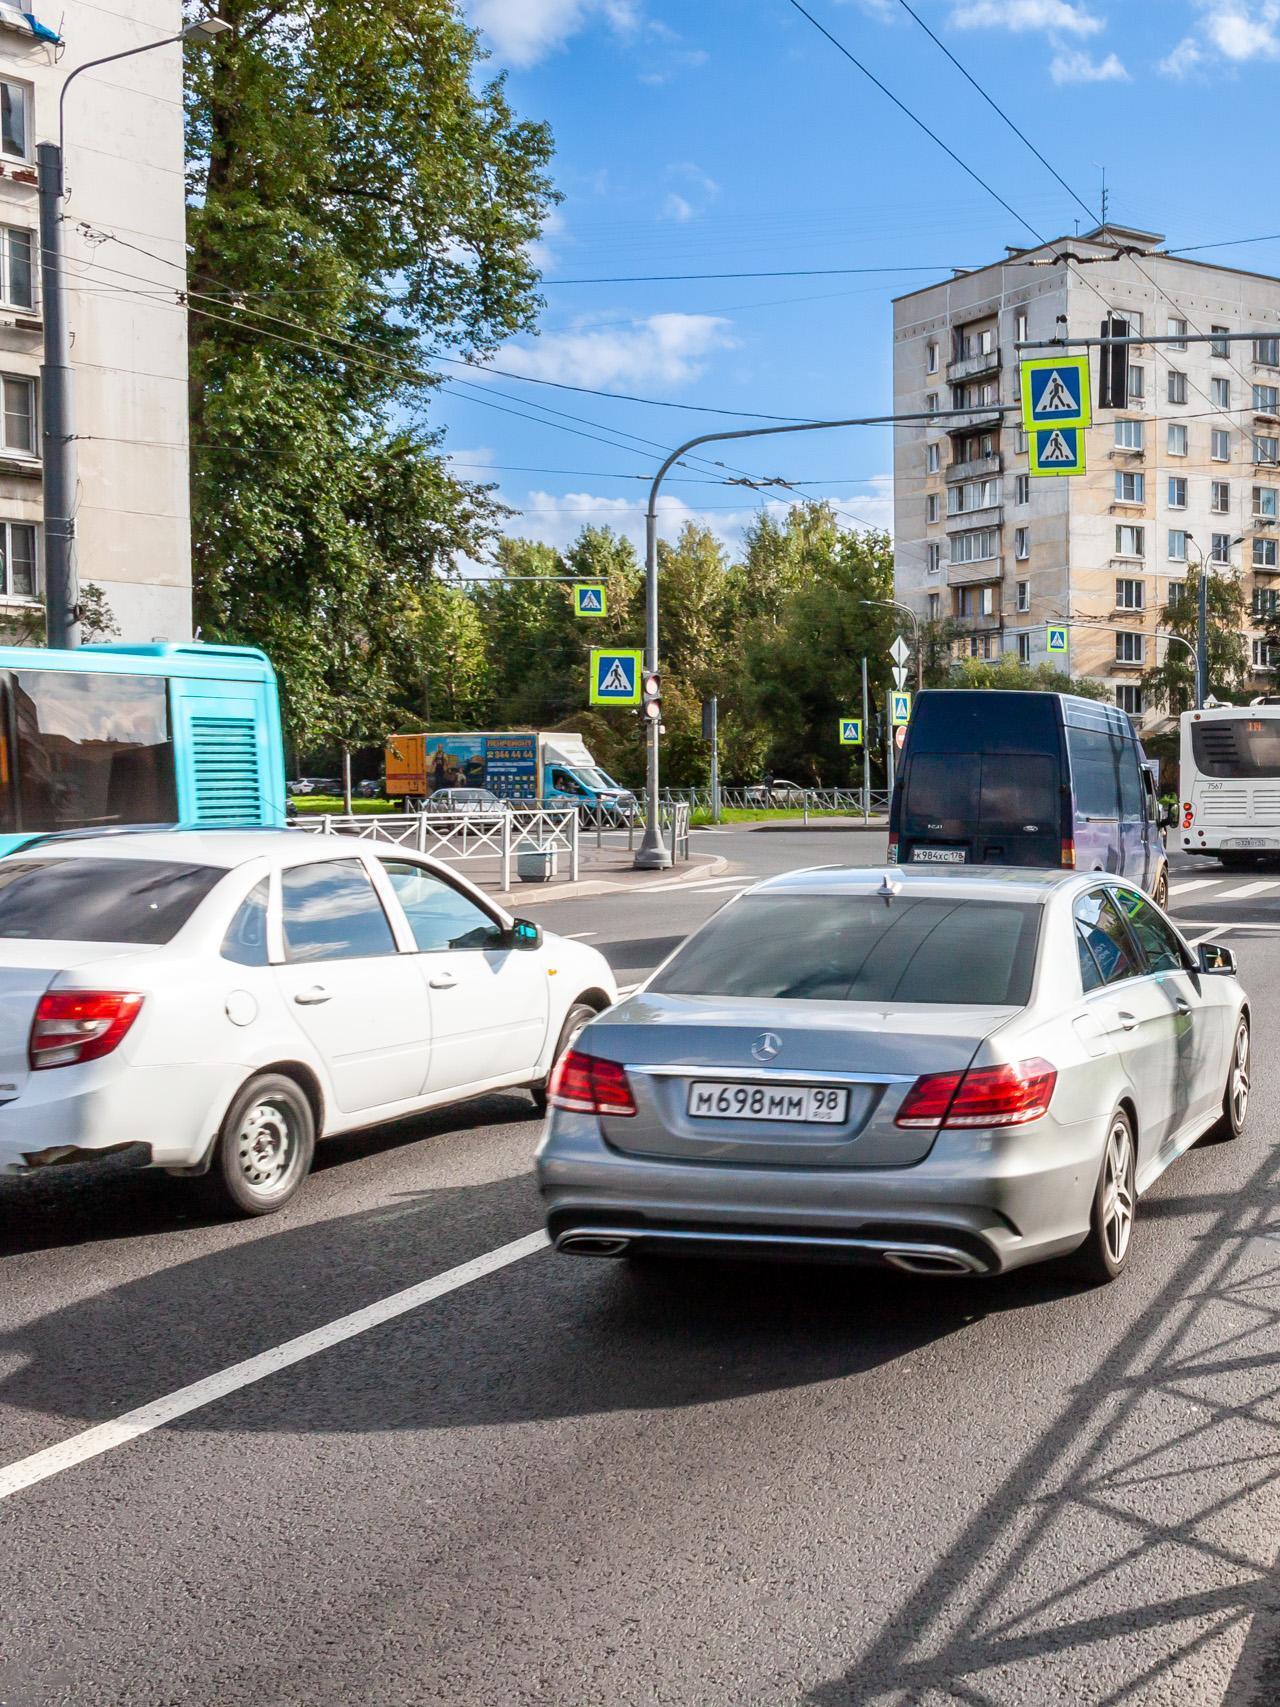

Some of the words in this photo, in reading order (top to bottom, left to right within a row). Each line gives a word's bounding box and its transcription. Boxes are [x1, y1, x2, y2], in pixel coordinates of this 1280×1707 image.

[1207, 782, 1223, 790] 7567
[695, 1087, 804, 1116] М698ММ
[813, 1090, 839, 1111] 98
